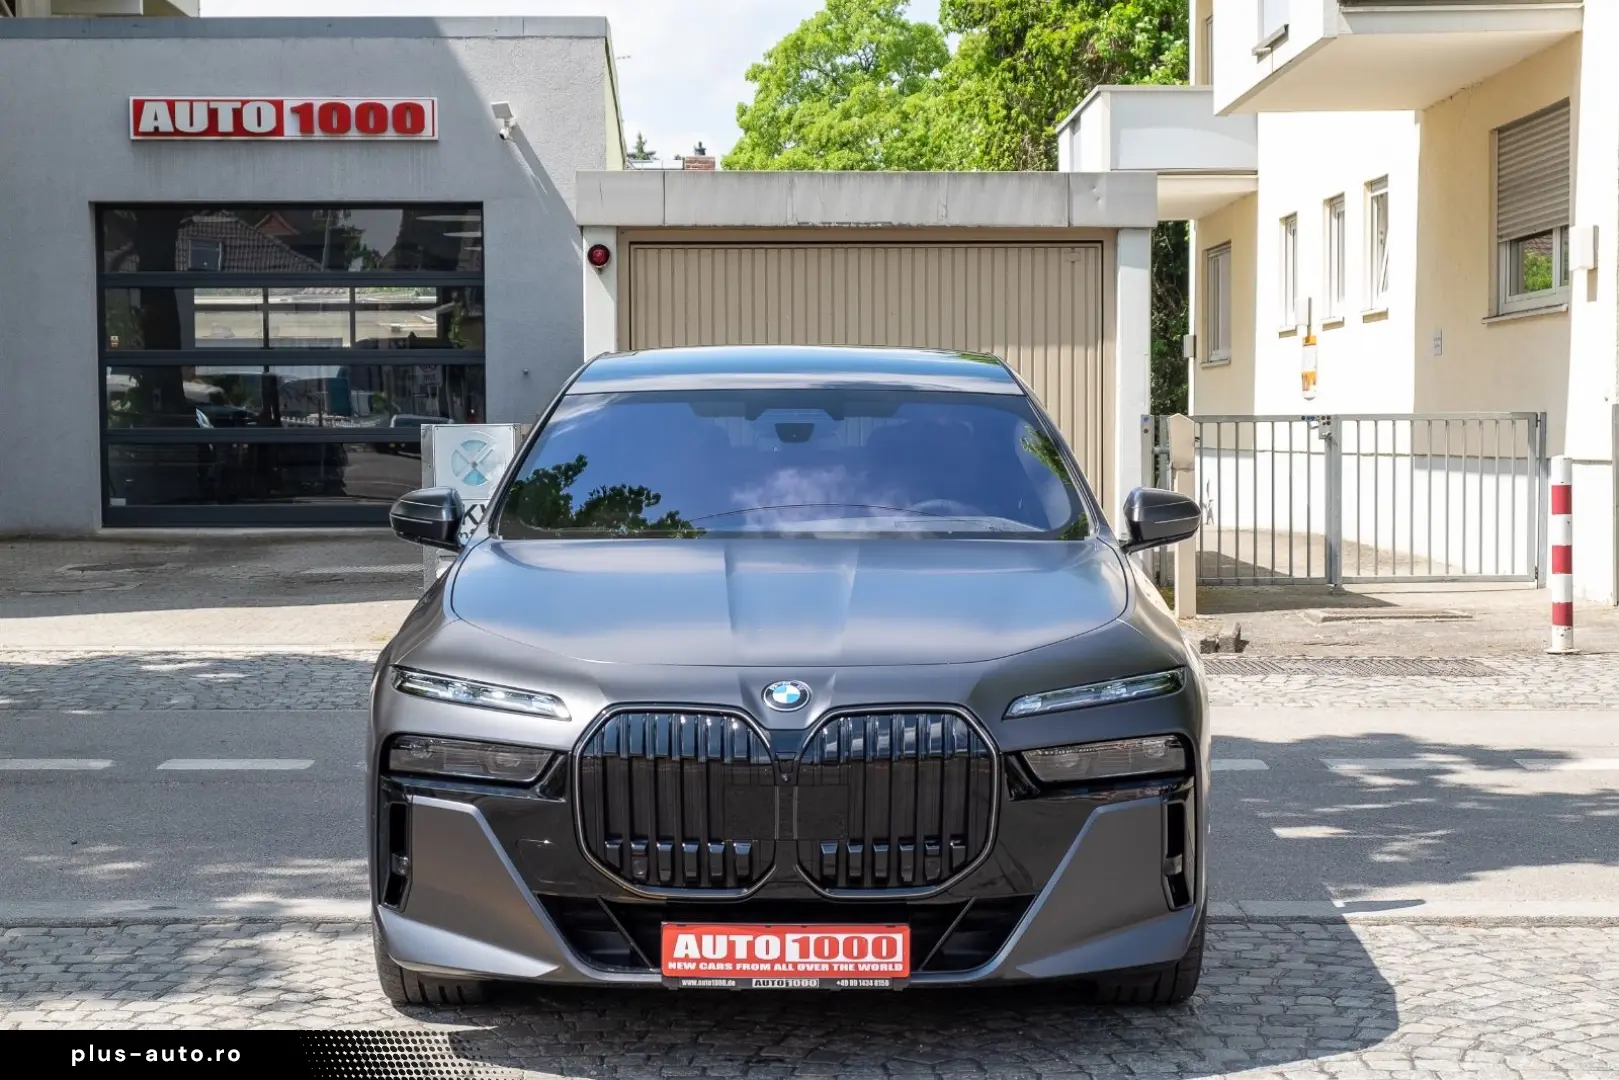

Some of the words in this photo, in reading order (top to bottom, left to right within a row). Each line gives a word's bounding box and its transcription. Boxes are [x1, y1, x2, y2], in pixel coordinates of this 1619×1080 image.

[138, 100, 277, 133] AUTO
[290, 101, 426, 134] 1000
[673, 933, 780, 960] AUTO
[791, 935, 898, 960] 1000
[668, 962, 696, 970] NEW
[699, 962, 733, 971] CARS
[736, 962, 771, 971] FROM
[774, 963, 795, 971] ALL
[797, 963, 829, 971] OVER
[832, 963, 855, 971] THE
[858, 963, 903, 972] WORLD
[754, 979, 784, 987] AUTO
[787, 979, 818, 987] 1000
